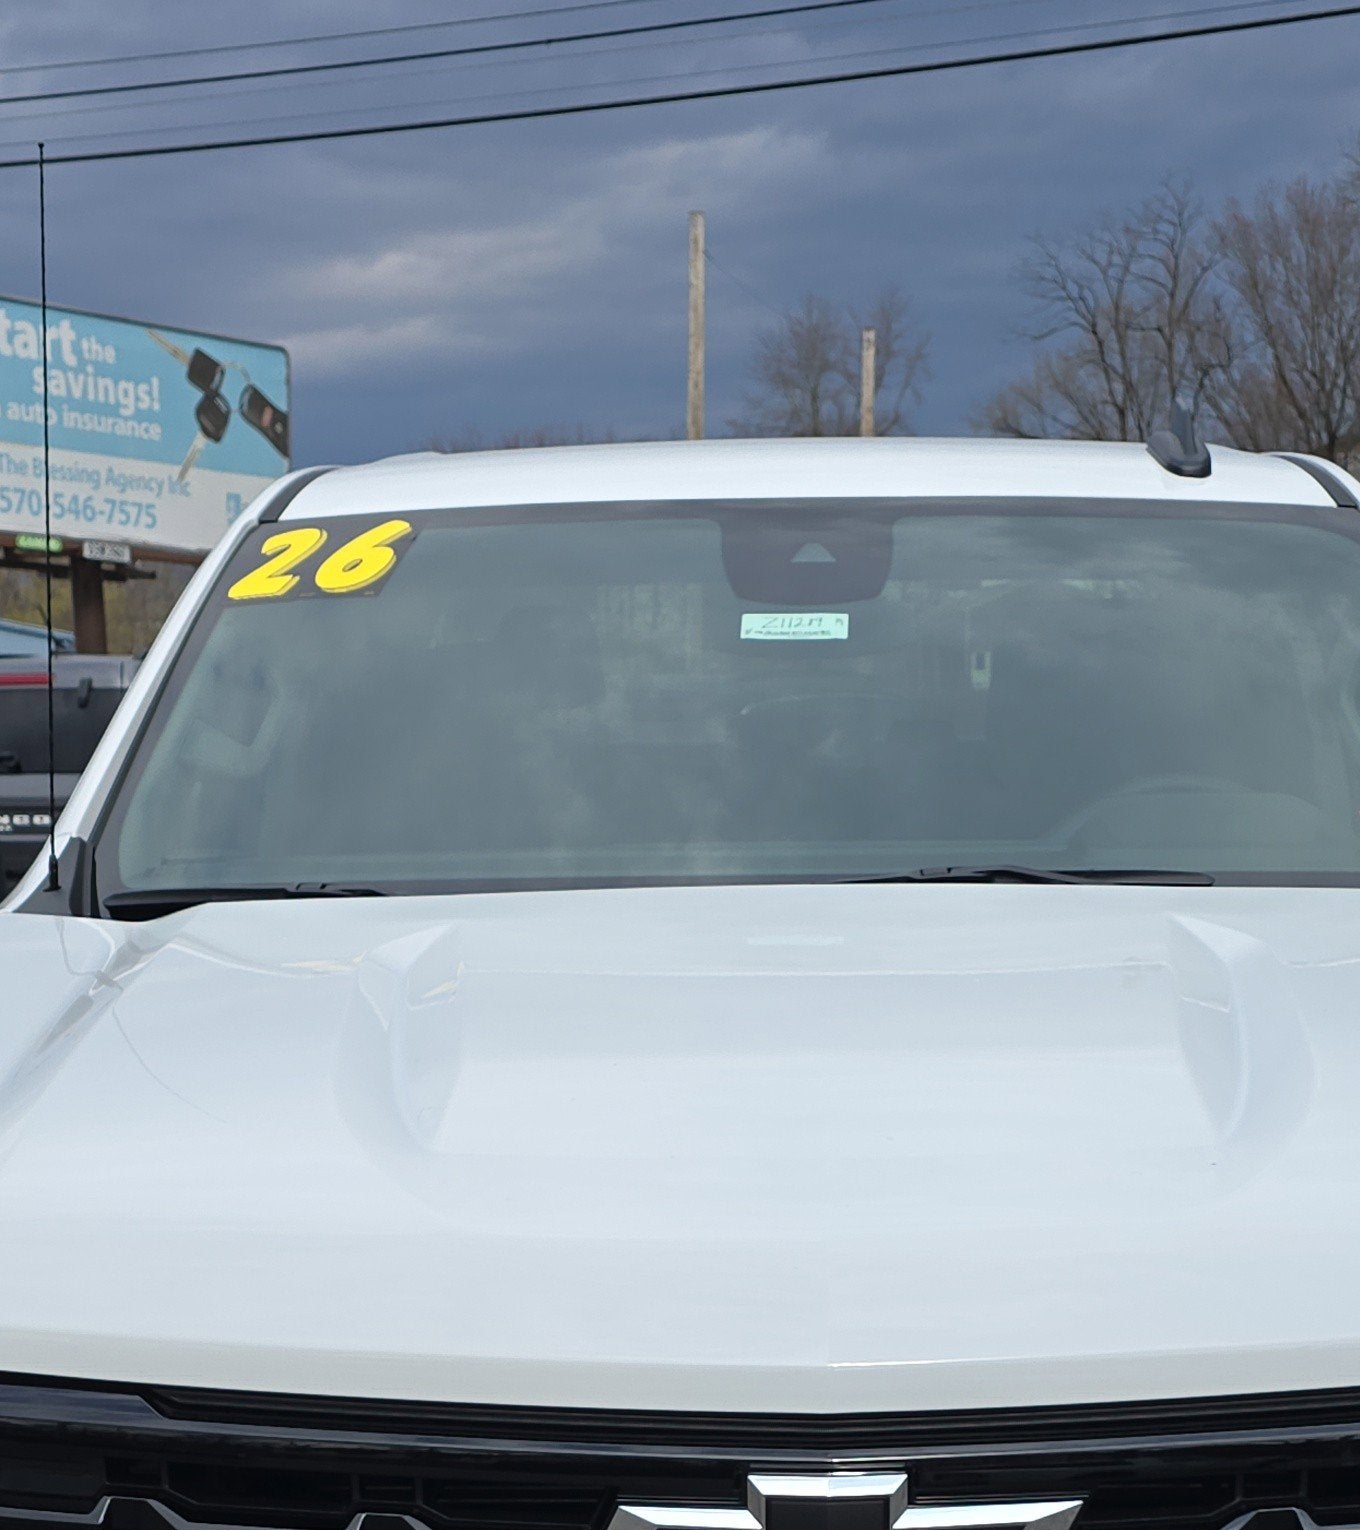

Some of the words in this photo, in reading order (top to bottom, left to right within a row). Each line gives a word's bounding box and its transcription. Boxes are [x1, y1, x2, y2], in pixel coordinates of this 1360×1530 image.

[81, 335, 116, 364] the
[32, 364, 161, 417] savings!
[6, 401, 58, 426] auto
[62, 404, 162, 441] insurance
[228, 519, 412, 600] 26
